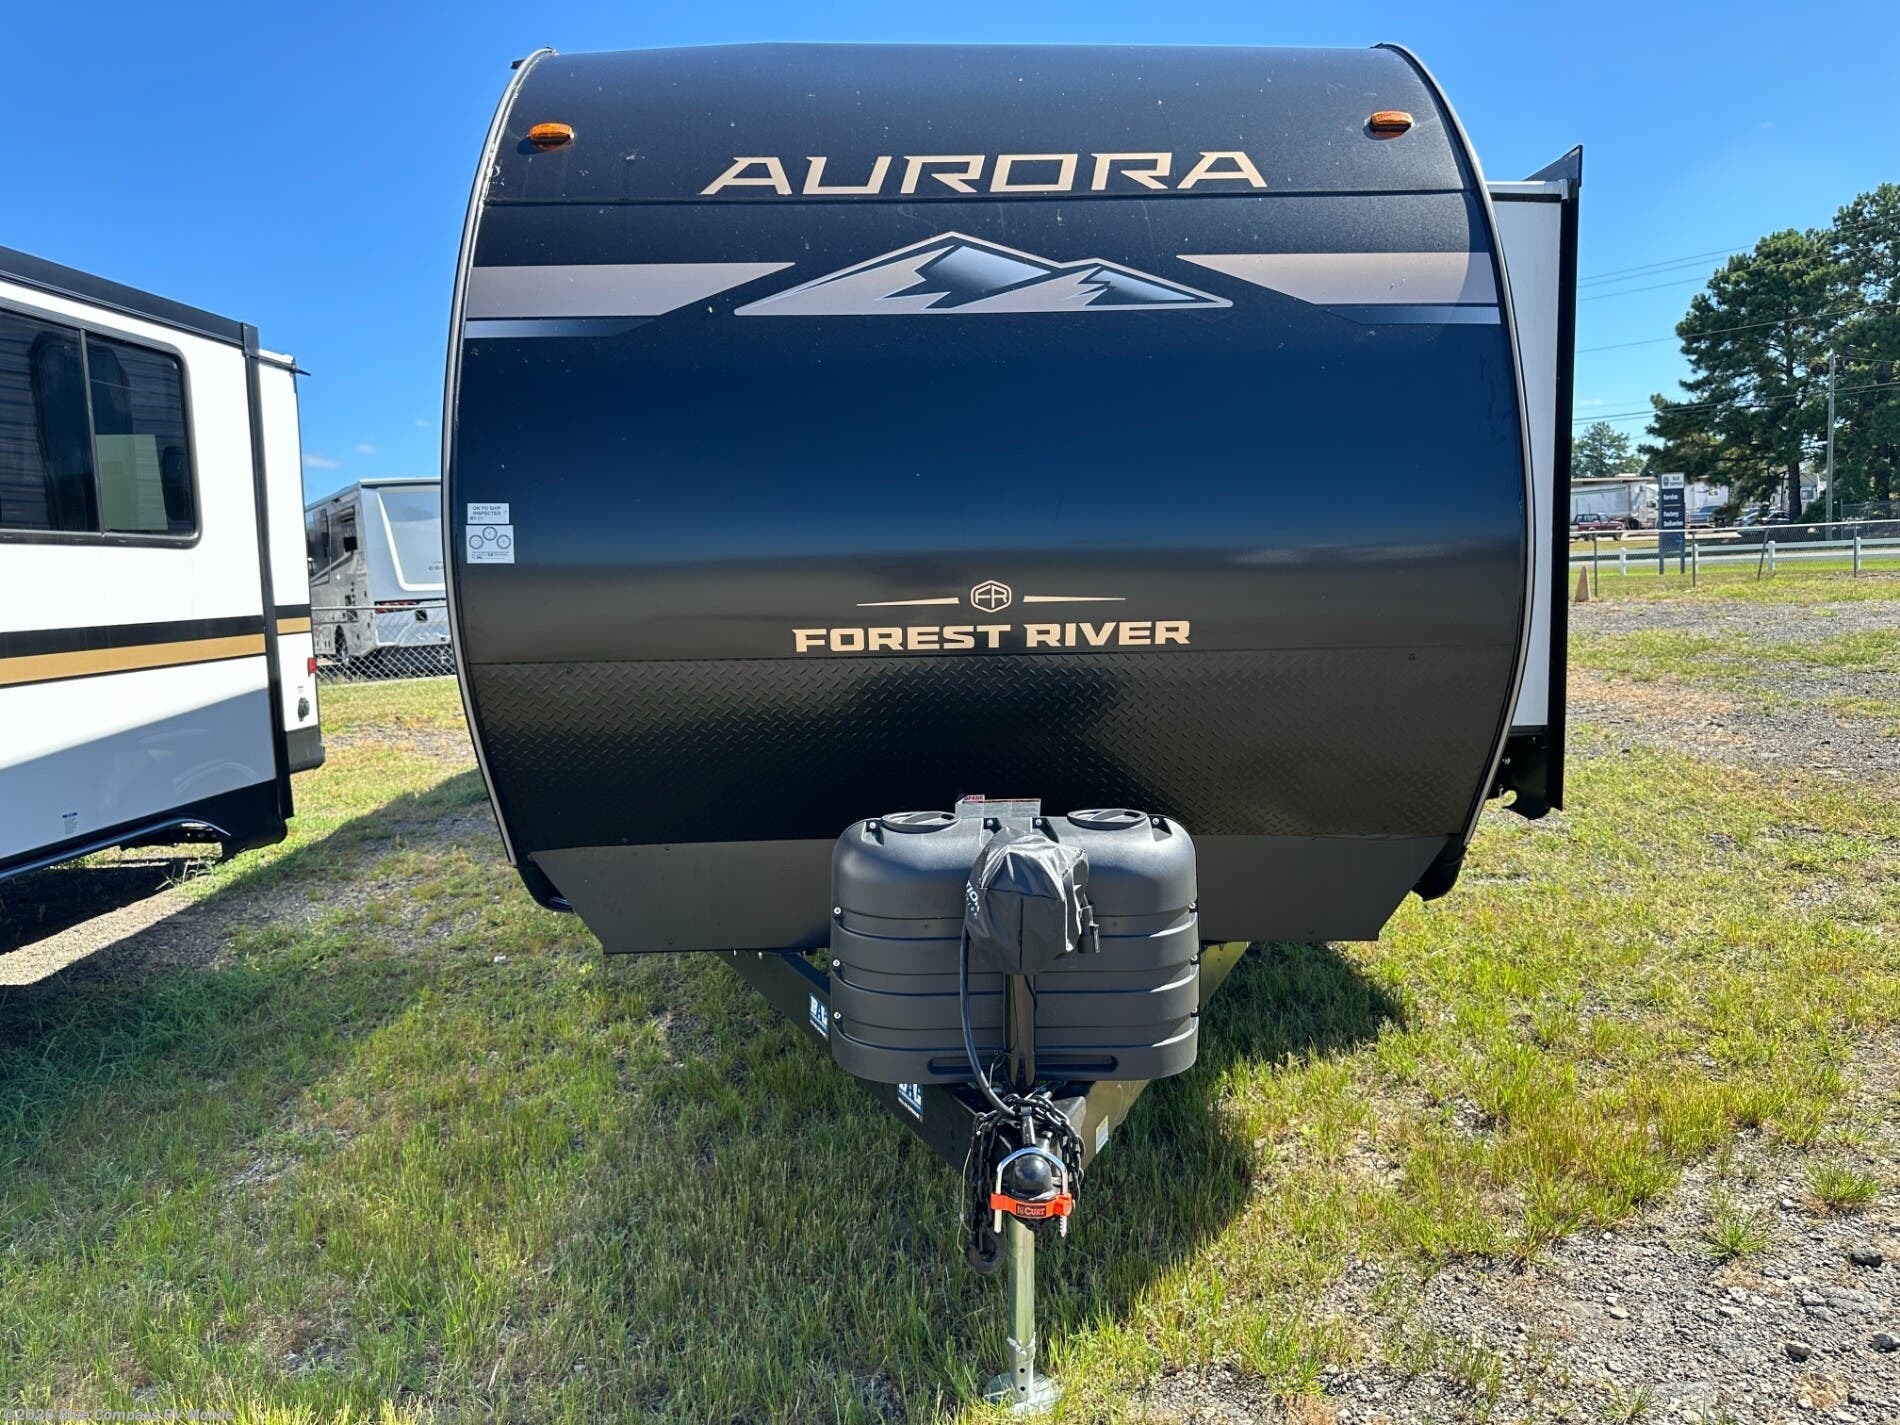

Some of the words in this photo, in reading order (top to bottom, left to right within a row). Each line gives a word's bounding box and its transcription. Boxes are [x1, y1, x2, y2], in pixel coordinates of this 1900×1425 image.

[698, 151, 1268, 195] AURORA
[792, 624, 1012, 653] FOREST
[1023, 620, 1191, 648] RIVER
